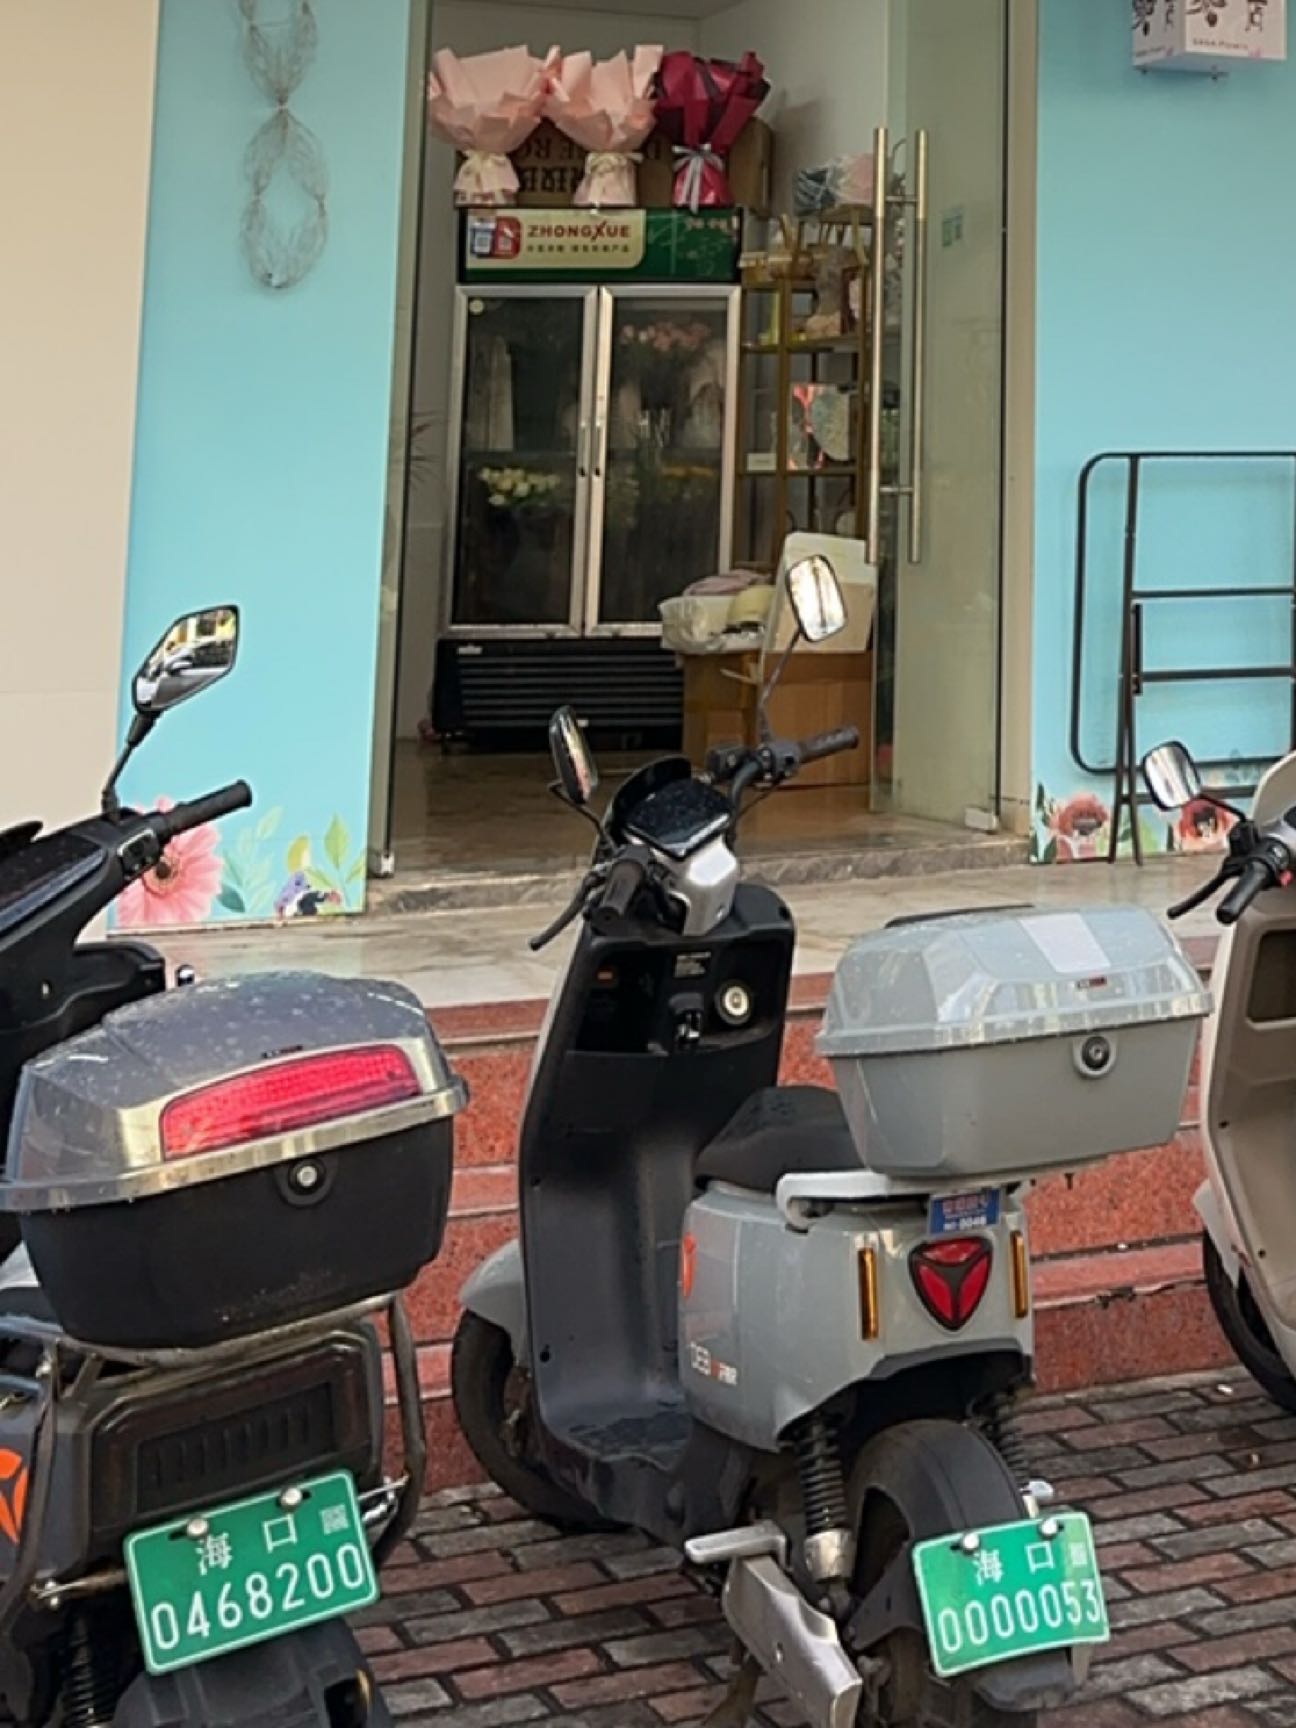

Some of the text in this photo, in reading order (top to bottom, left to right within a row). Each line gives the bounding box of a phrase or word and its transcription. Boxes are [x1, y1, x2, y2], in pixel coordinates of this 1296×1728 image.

[527, 220, 632, 243] ZHONGXUE
[195, 1514, 298, 1576] 海口
[972, 1540, 1056, 1587] 海口
[150, 1542, 364, 1650] 0468200
[937, 1579, 1101, 1654] 0000053
